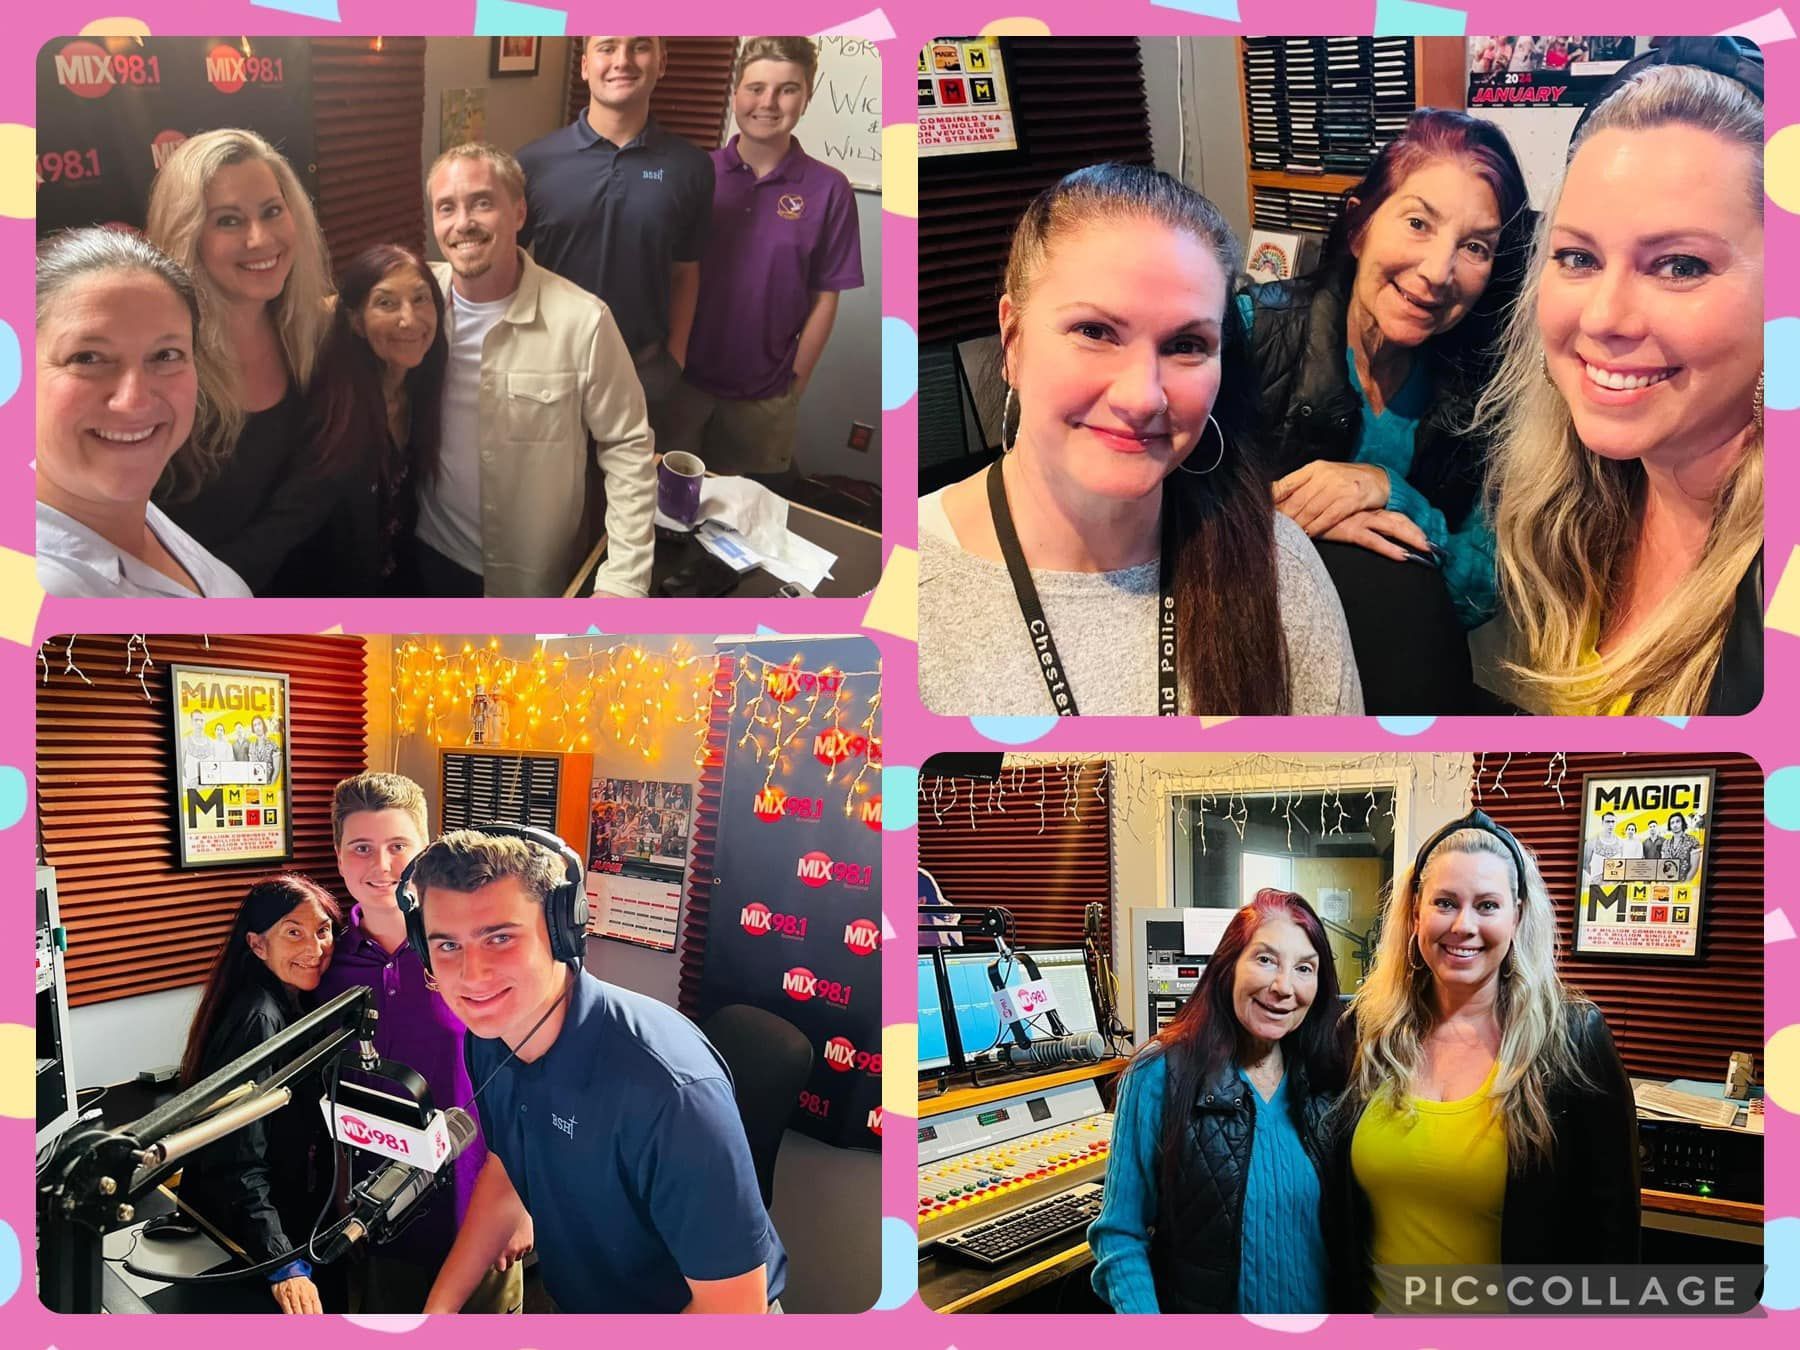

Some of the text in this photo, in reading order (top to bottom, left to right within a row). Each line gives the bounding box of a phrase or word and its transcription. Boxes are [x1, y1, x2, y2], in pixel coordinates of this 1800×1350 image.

[1472, 86, 1567, 103] JANUARY
[945, 133, 995, 143] STREAMS
[1161, 596, 1175, 673] Police
[181, 680, 275, 713] MAGIC!
[1594, 783, 1701, 811] MAGIC!
